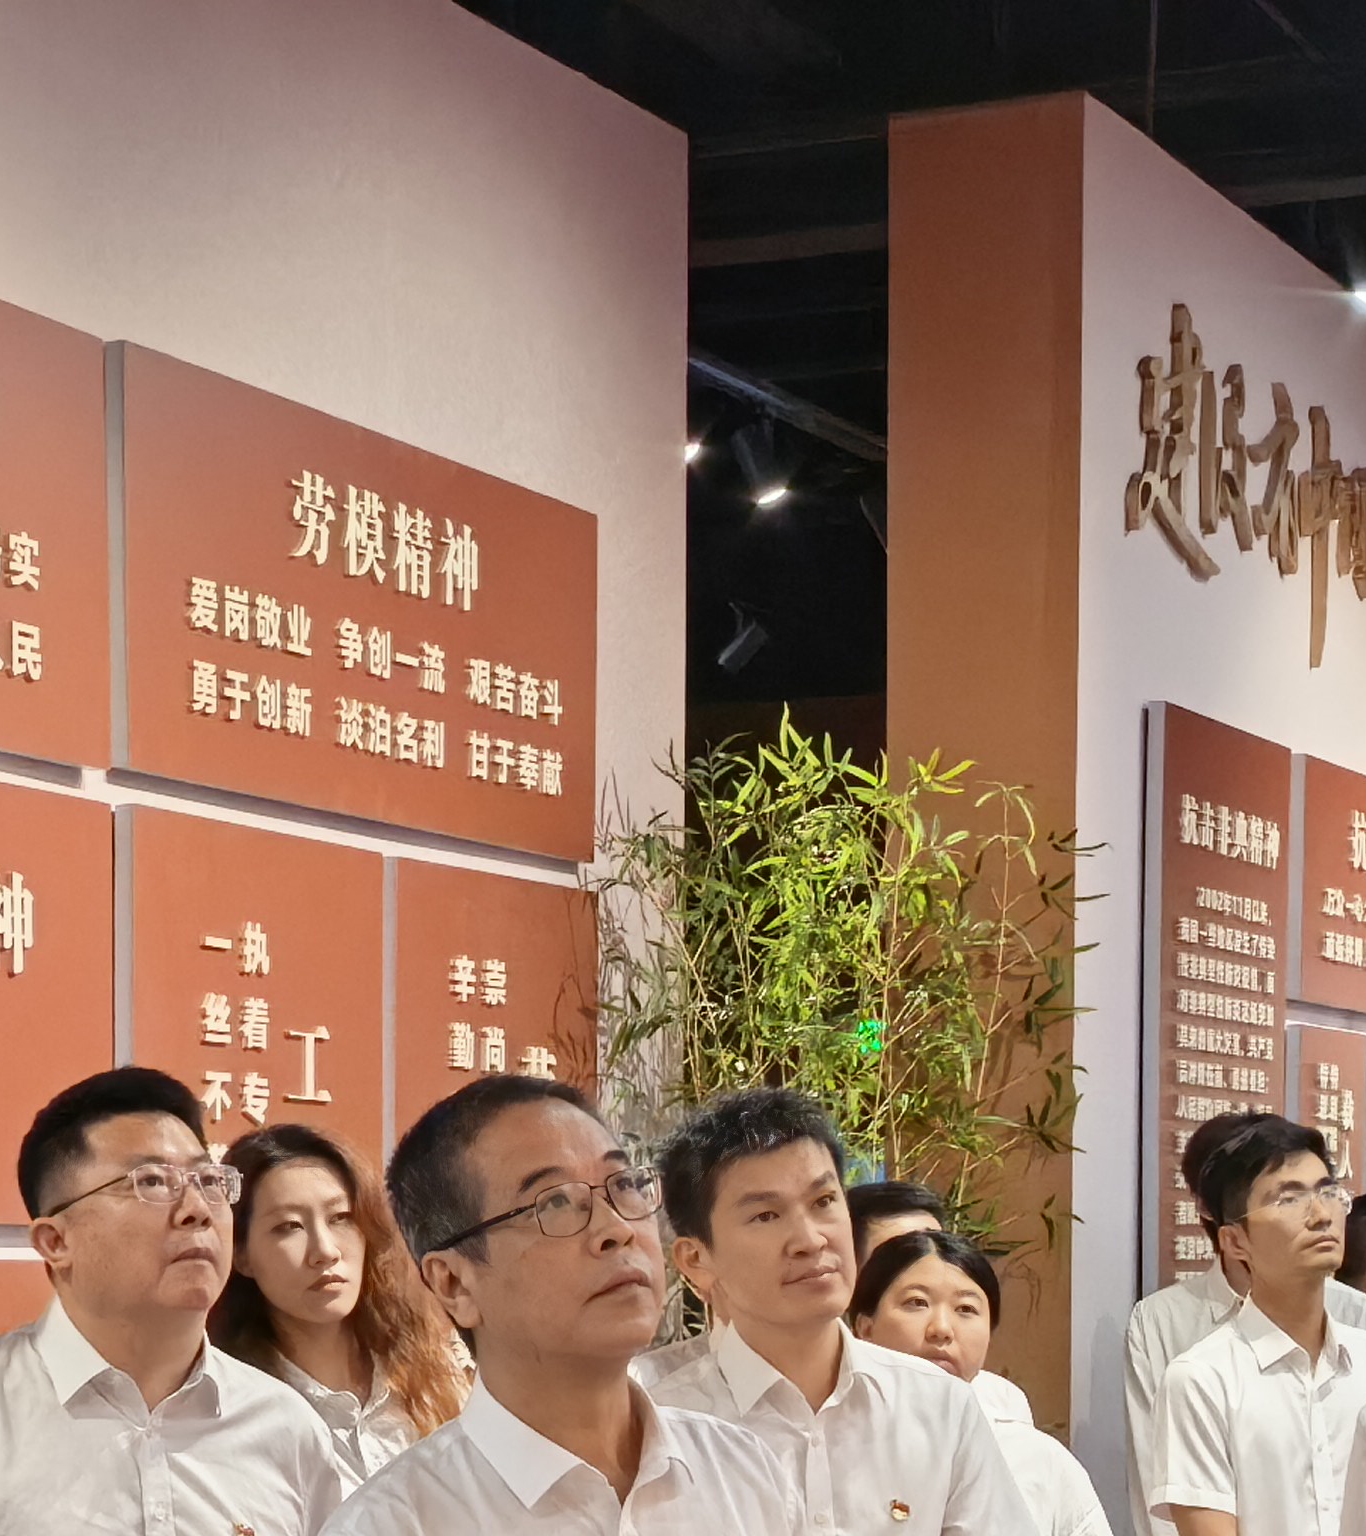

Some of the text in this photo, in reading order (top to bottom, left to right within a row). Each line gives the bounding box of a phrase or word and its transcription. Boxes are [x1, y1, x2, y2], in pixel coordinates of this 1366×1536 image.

[290, 470, 479, 611] 劳模精神
[188, 577, 563, 726] 爱岗敬业 争创一流 艰苦奋斗
[191, 659, 563, 796] 勇于创新 淡泊名利 甘于奉献
